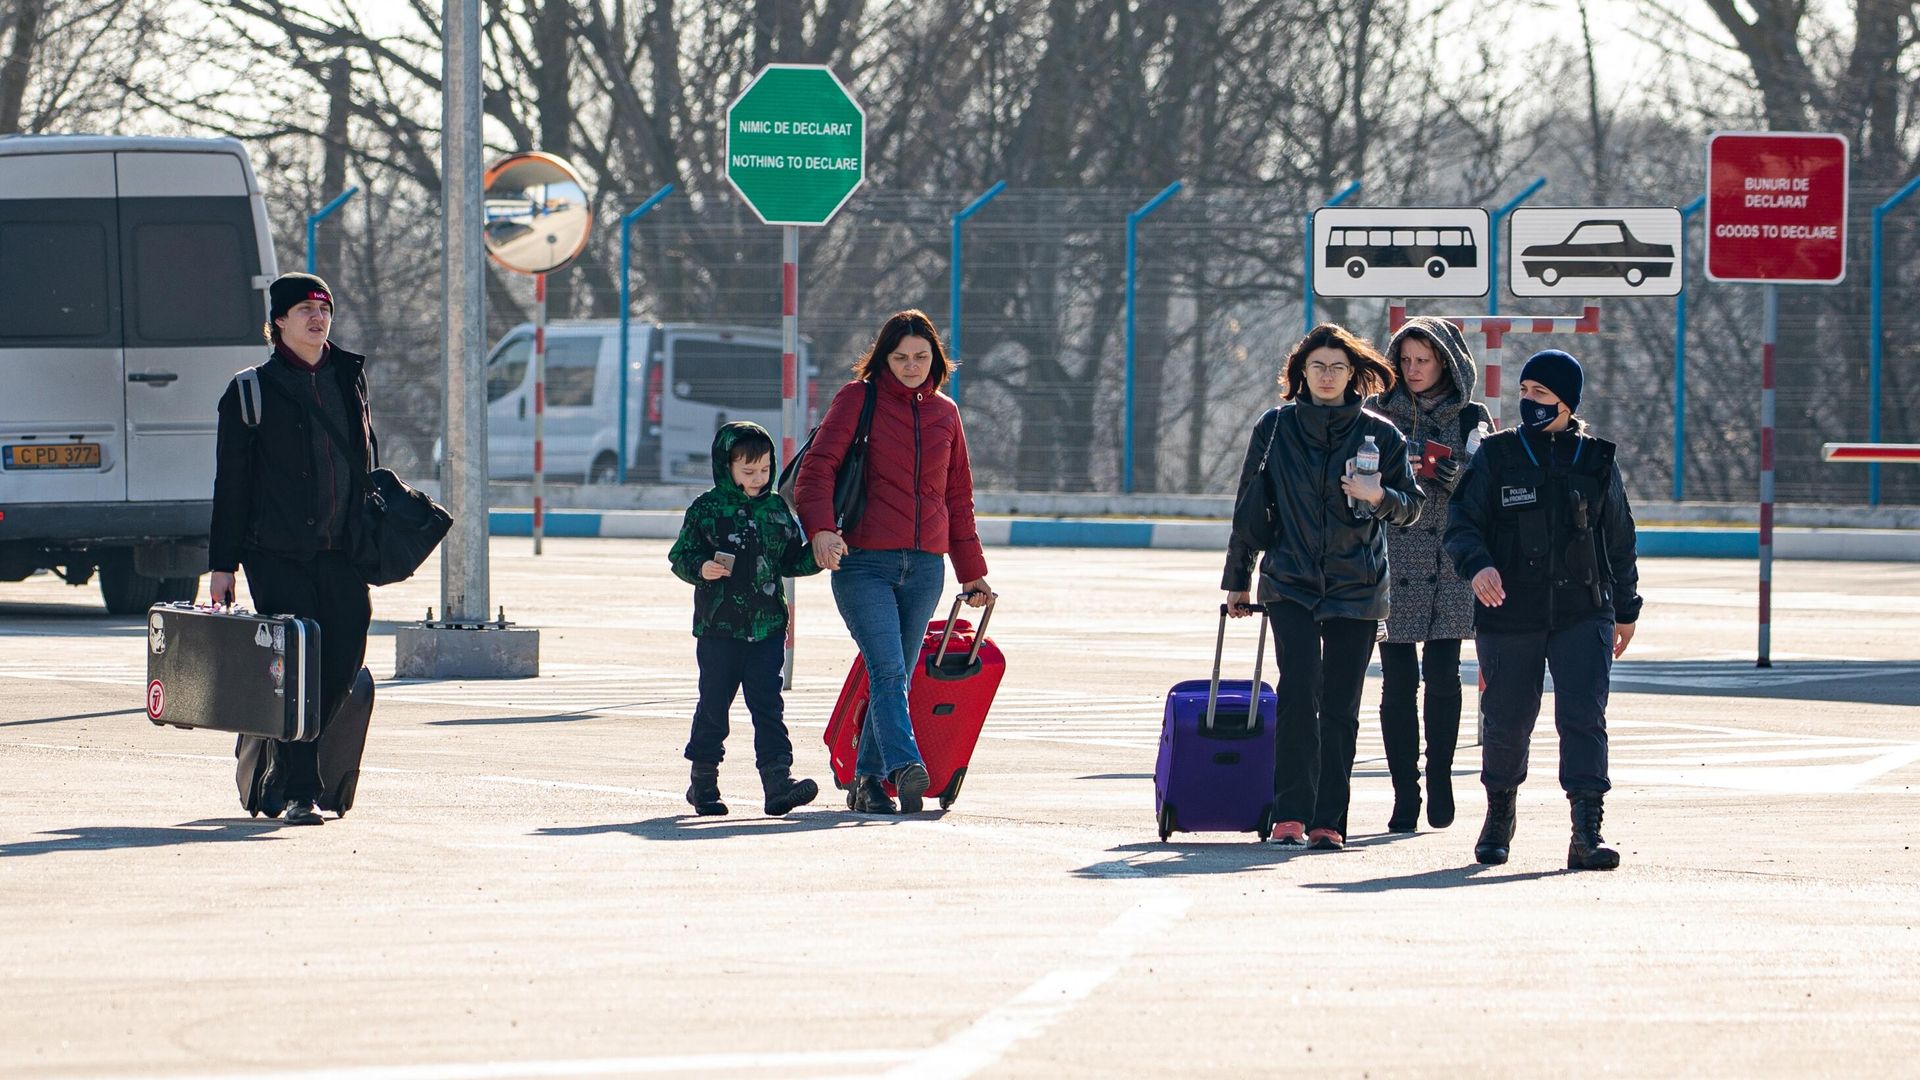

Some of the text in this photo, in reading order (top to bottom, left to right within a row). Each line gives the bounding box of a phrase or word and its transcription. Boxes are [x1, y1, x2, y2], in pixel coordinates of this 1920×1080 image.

[739, 120, 853, 136] NIMIC DE DECLARAT
[732, 154, 858, 171] NOTHING TO DECLARE
[1744, 177, 1810, 192] BUNURI DE
[1744, 194, 1809, 209] DECLARAT
[1715, 224, 1838, 240] GOODS TO DECLARE
[20, 448, 32, 463] C
[64, 446, 92, 463] 377
